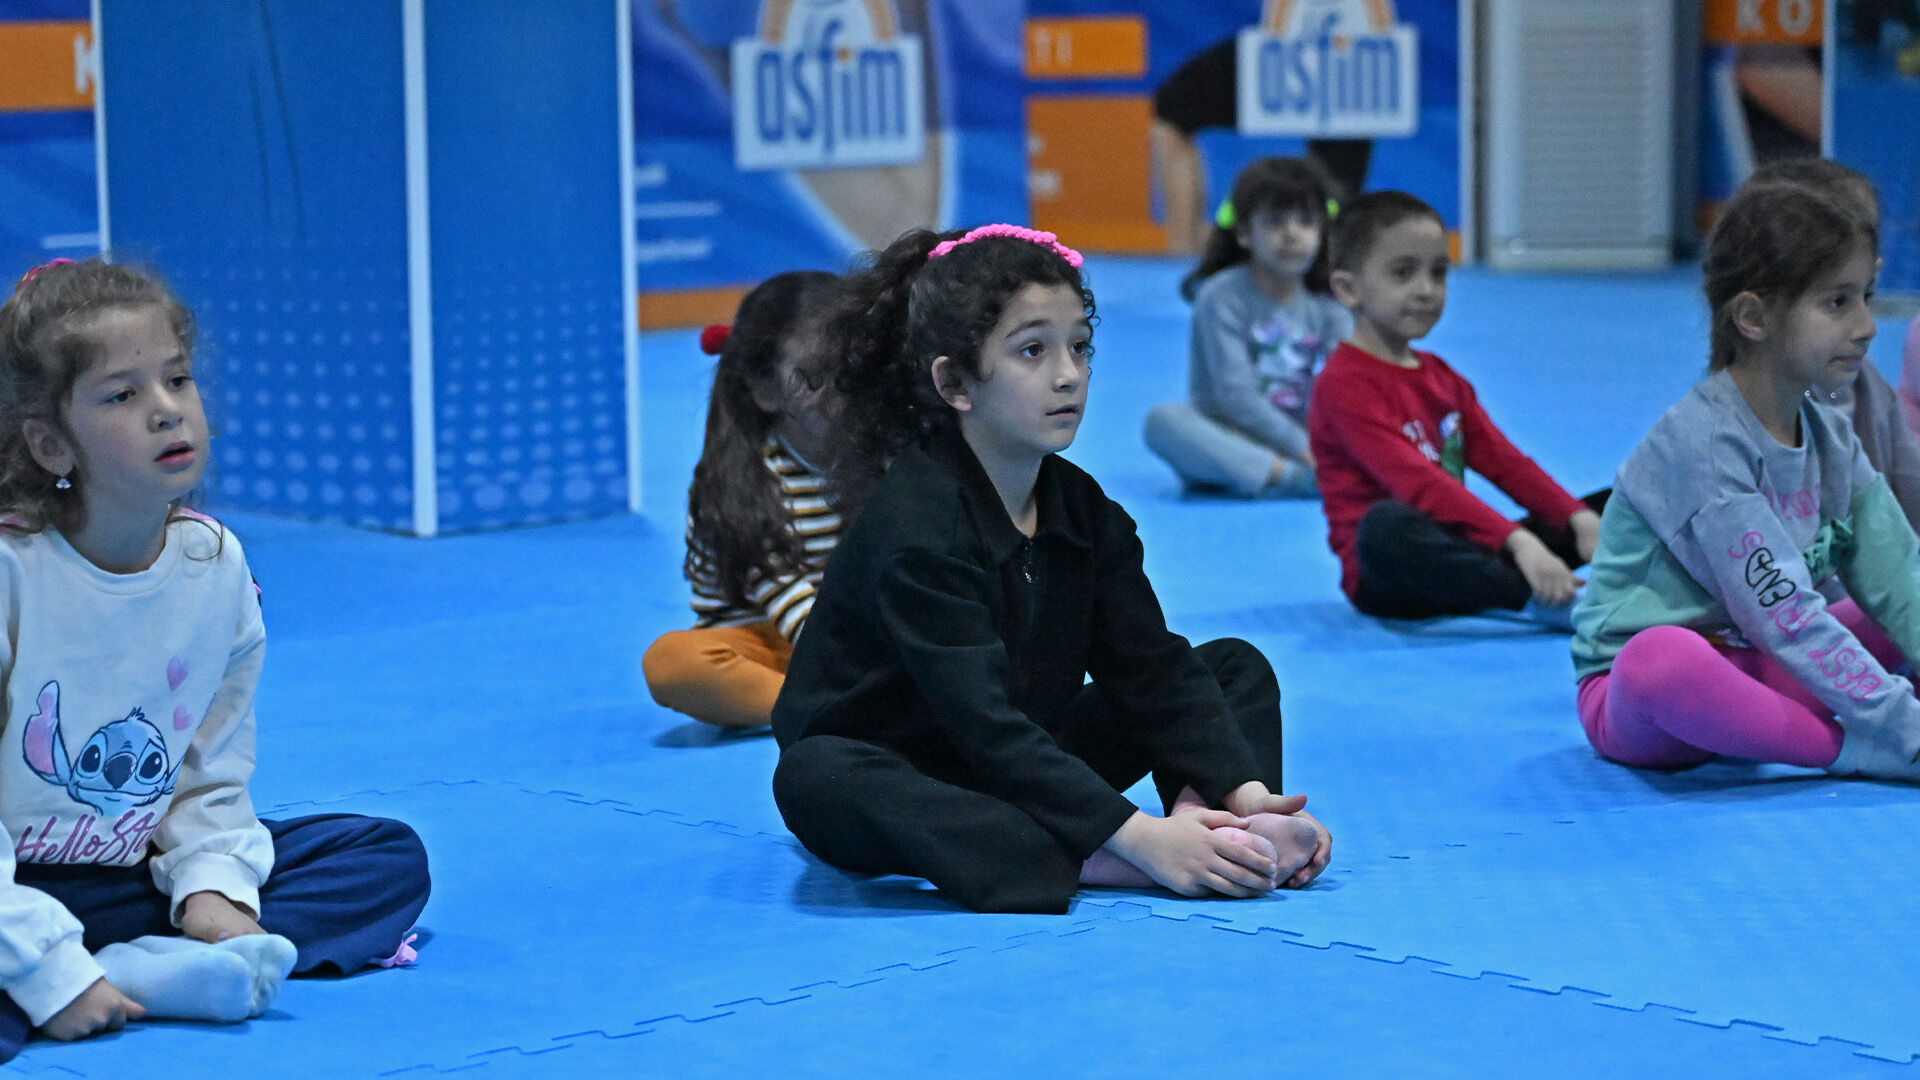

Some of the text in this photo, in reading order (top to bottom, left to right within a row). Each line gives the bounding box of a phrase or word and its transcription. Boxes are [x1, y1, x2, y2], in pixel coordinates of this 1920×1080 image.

[1728, 531, 1819, 641] FRIENDS
[1807, 630, 1883, 701] BEST
[15, 814, 108, 863] Hello
